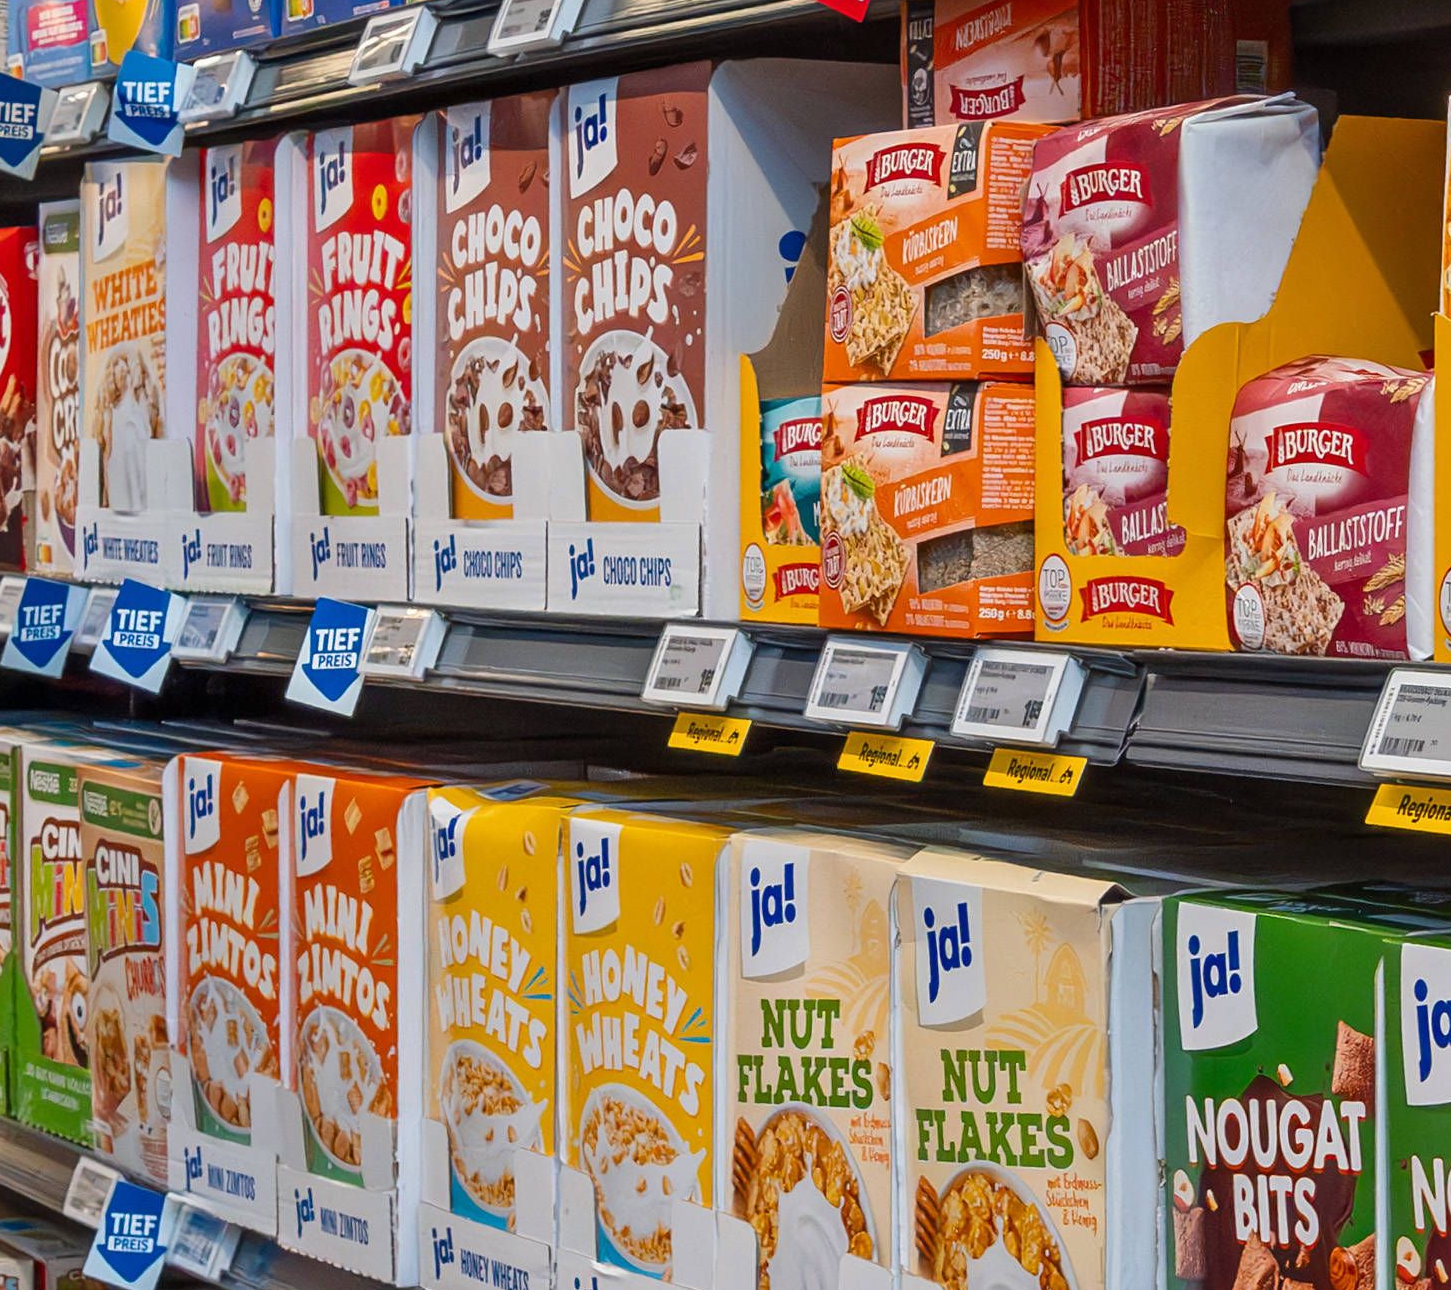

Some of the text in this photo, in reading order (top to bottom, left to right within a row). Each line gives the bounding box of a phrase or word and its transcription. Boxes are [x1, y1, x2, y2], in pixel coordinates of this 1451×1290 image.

[122, 79, 171, 106] TIEF
[951, 152, 977, 174] EXTRA
[576, 189, 678, 255] CHOCO
[902, 216, 958, 264] KÜRBISKERN
[323, 231, 407, 289] FRUIT
[92, 270, 158, 314] WHITE
[319, 294, 396, 350] RINGS
[1307, 505, 1404, 561] BALLASTSTOFF
[602, 556, 671, 589] CHOCO CHIPS
[315, 629, 358, 654] TIEF
[315, 651, 356, 670] PREIS
[304, 883, 373, 952] MINI
[297, 949, 391, 1031] ZIMTOS
[580, 945, 688, 1036] HONEY
[760, 998, 841, 1050] NUT
[574, 1012, 706, 1119] WHEATS
[737, 1054, 873, 1110] FLAKES
